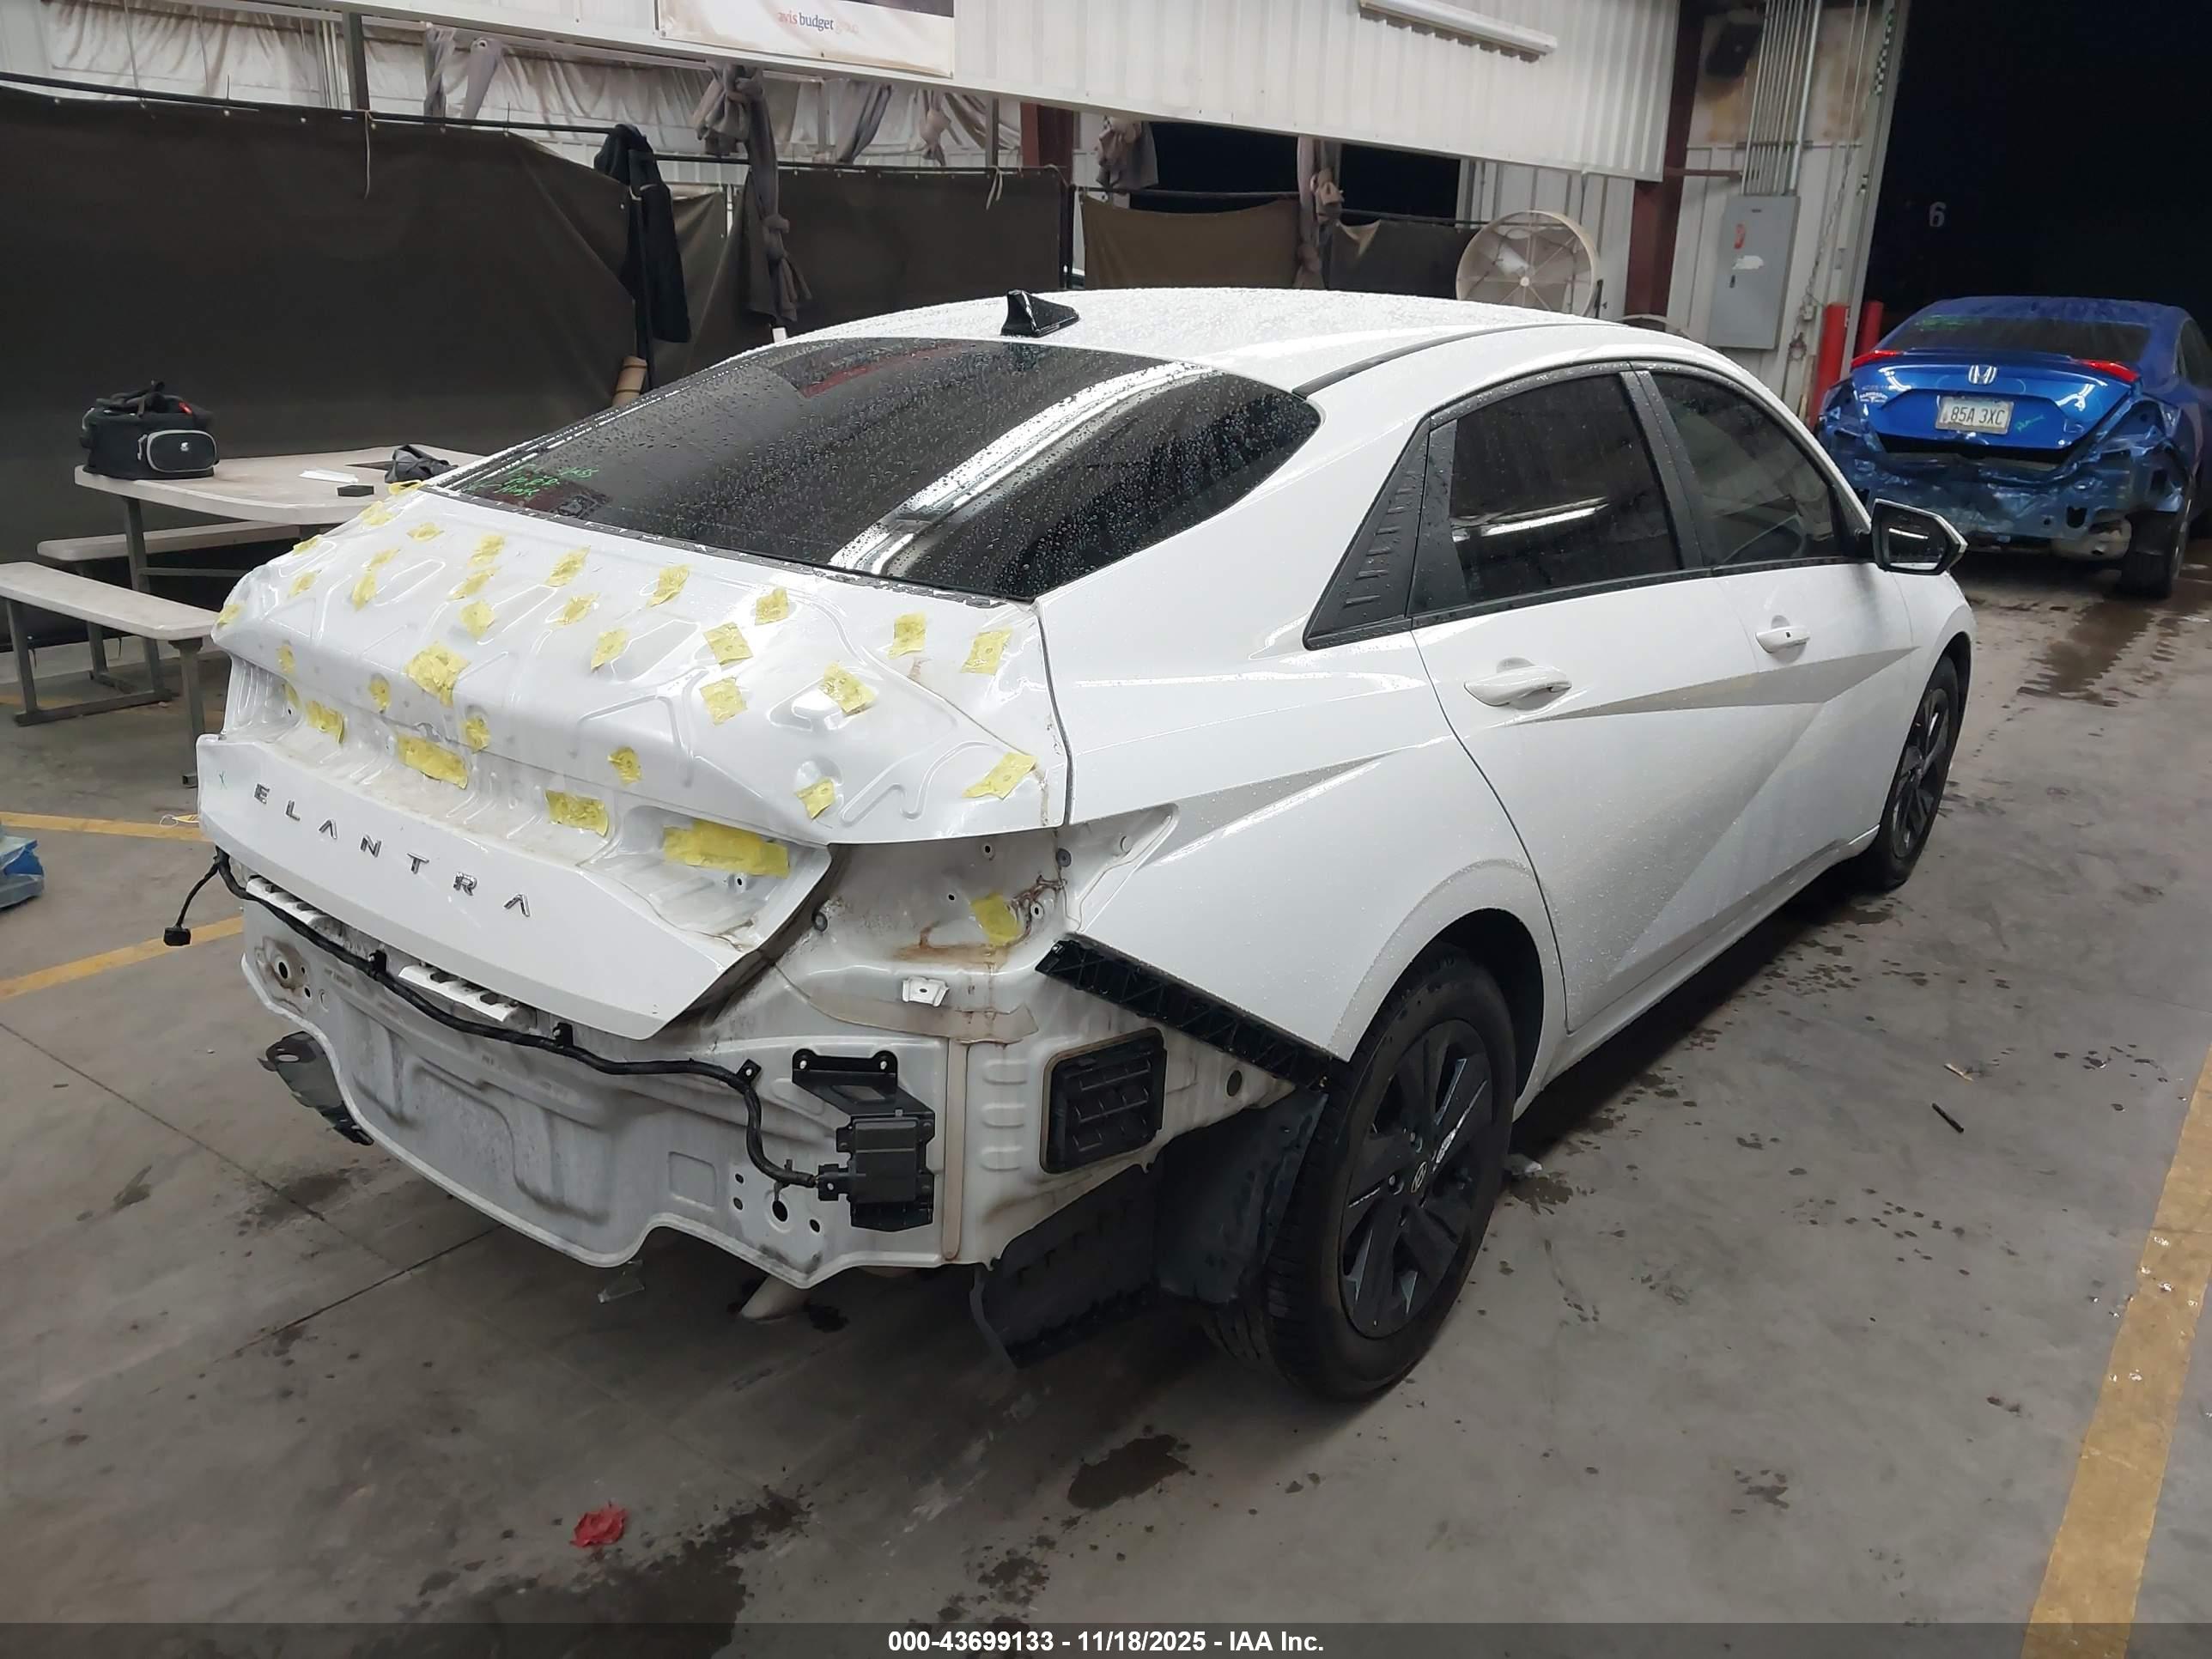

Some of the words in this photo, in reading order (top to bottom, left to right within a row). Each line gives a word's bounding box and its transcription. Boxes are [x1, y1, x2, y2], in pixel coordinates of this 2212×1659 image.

[778, 10, 798, 24] avis
[799, 12, 834, 32] budget
[1929, 201, 1947, 227] 6
[1950, 406, 1976, 422] 85A
[1978, 408, 2006, 426] 3XC
[254, 783, 531, 917] ELANTRA
